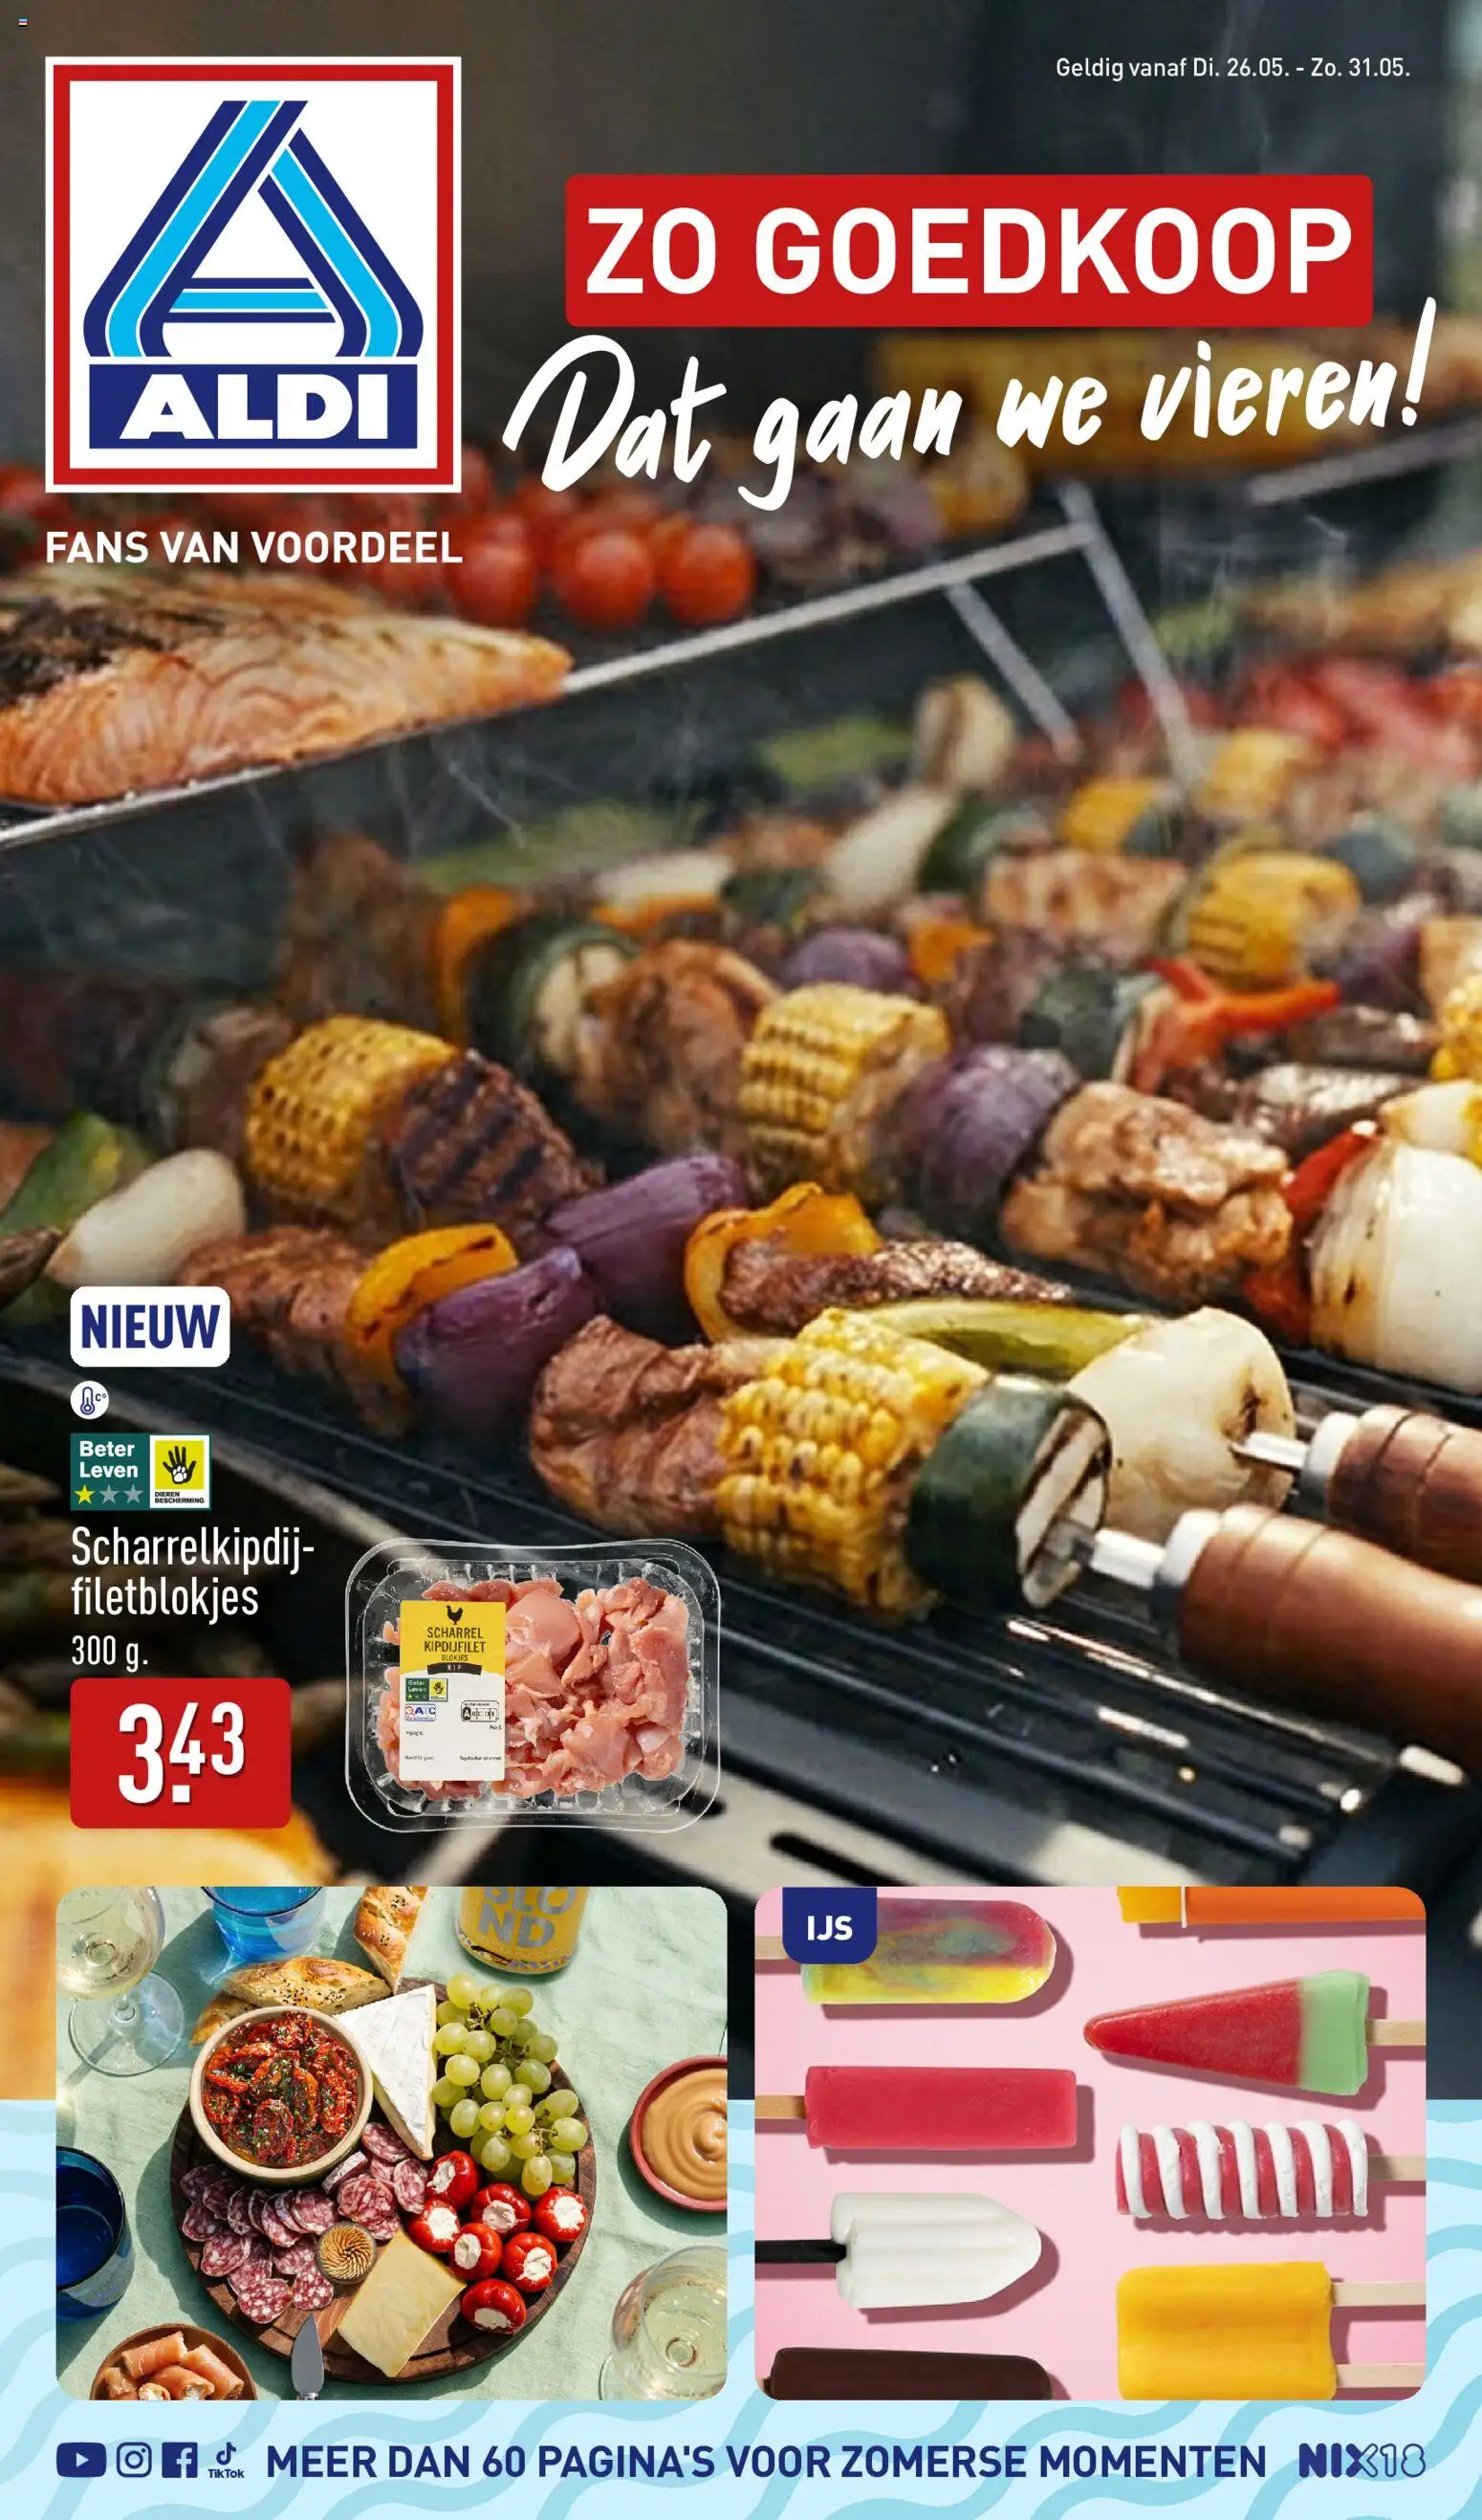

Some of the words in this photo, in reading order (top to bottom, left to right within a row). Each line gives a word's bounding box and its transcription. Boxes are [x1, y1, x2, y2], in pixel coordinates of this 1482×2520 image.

[1057, 57, 1123, 82] Geldig
[1128, 57, 1188, 77] vanaf
[1193, 57, 1220, 77] Di.
[1227, 57, 1290, 77] 26.05.
[1311, 57, 1342, 77] Zo.
[1349, 57, 1410, 77] 31.05.
[587, 207, 716, 295] ZO
[755, 207, 1352, 295] GOEDKOOP
[120, 374, 388, 440] ALDI
[502, 334, 728, 493] Dat
[737, 387, 963, 512] gaan
[995, 370, 1105, 450] we
[1139, 296, 1437, 441] vieren!
[47, 531, 148, 563] FANS
[160, 531, 238, 563] VAN
[251, 531, 463, 563] VOORDEEL
[81, 1304, 221, 1349] NIEUW
[79, 1440, 135, 1457] Beter
[79, 1461, 138, 1479] Leven
[72, 1525, 315, 1575] Scharrelkipdij-
[71, 1576, 258, 1626] filetblokjes
[424, 1640, 487, 1654] KIPDIJFILET
[426, 1627, 484, 1639] SCHARREL
[72, 1634, 116, 1665] 300
[126, 1642, 148, 1673] g.
[441, 1654, 469, 1662] BLOKJES
[479, 1902, 556, 1947] ND
[807, 1915, 853, 1940] IJS
[207, 2468, 245, 2479] TikTok
[267, 2445, 378, 2478] MEER
[388, 2445, 469, 2478] DAN
[482, 2445, 526, 2478] 60
[538, 2445, 715, 2478] PAGINA'S
[725, 2444, 831, 2478] VOOR
[841, 2444, 1027, 2478] ZOMERSE
[1040, 2444, 1266, 2478] MOMENTEN
[1298, 2443, 1427, 2479] NIX18
